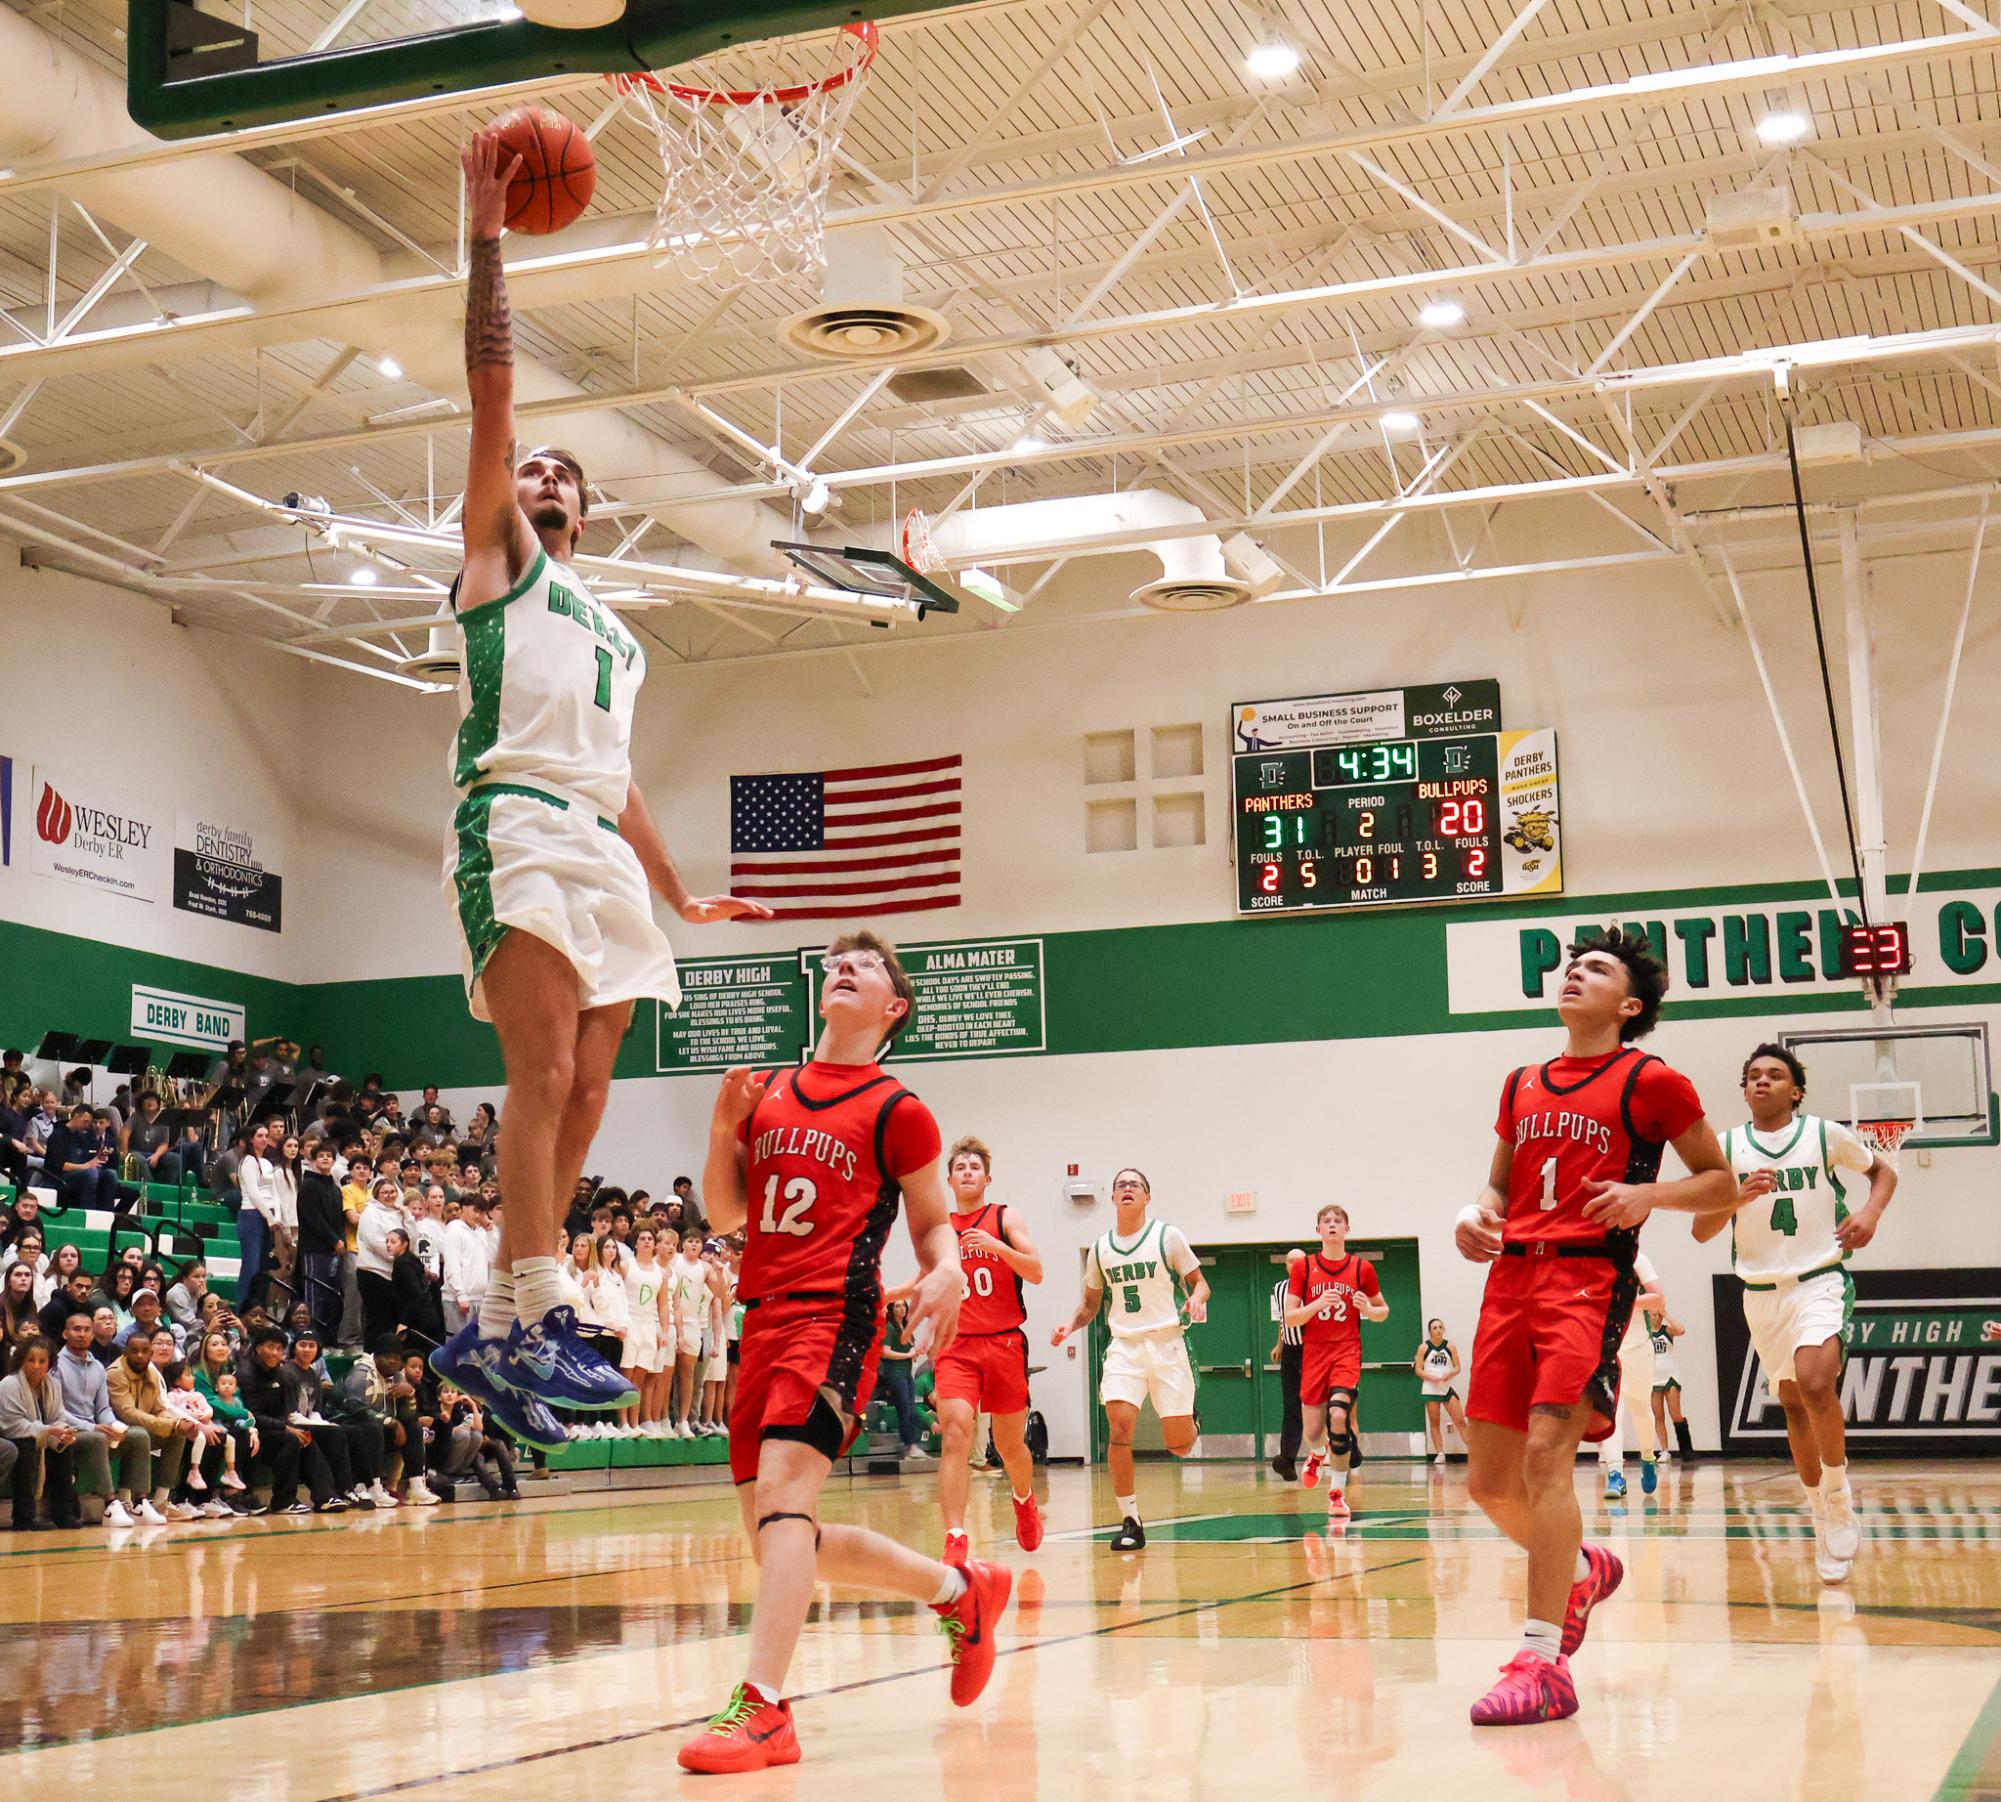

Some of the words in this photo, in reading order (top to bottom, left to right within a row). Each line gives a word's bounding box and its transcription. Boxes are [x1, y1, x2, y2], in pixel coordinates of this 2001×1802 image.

[548, 580, 637, 671] DERBY
[594, 645, 613, 712] 1
[1262, 713, 1295, 724] SMALL
[1298, 709, 1348, 720] BUSINESS
[1350, 703, 1399, 715] SUPPORT
[1288, 721, 1300, 730] On
[1301, 720, 1317, 729] and
[1319, 719, 1333, 728] Off
[1334, 718, 1348, 726] the
[1350, 716, 1374, 725] Court
[1413, 708, 1493, 726] BOXELDER
[1429, 723, 1477, 734] CONSULTING
[1338, 747, 1413, 780] 4:34
[1514, 751, 1544, 767] DERBY
[1505, 762, 1553, 781] PANTHERS
[1418, 778, 1488, 799] BULLPUPS
[1507, 788, 1553, 808] SHOCKERS
[1245, 793, 1313, 812] PANTHERS
[1348, 796, 1385, 809] PERIOD
[74, 804, 152, 849] WESLEY
[1359, 812, 1375, 837] 2
[1440, 800, 1483, 835] 20
[196, 820, 222, 839] derby
[223, 825, 253, 848] family
[1264, 815, 1304, 848] 31
[74, 833, 106, 858] Derby
[109, 841, 123, 860] ER
[196, 835, 252, 867] DENTISTRY
[1334, 845, 1374, 858] PLAYER
[1378, 843, 1405, 854] FOUL
[1416, 840, 1444, 852] T.O.L.
[1455, 836, 1489, 849] FOULS
[1250, 851, 1283, 864] FOULS
[1296, 849, 1325, 861] T.O.L.
[1468, 849, 1485, 876] 2
[195, 858, 202, 871] &
[203, 861, 263, 888] ORTHODONTICS
[1300, 862, 1317, 888] 5
[1423, 853, 1437, 879] 3
[1263, 864, 1279, 891] 2
[1456, 880, 1491, 893] SCORE
[1251, 895, 1284, 908] SCORE
[1351, 888, 1387, 900] MATCH
[926, 952, 966, 971] ALMA
[967, 949, 1015, 968] MATER
[685, 969, 734, 987] DERBY
[736, 966, 771, 983] HIGH
[916, 977, 941, 987] SCHOOL
[942, 976, 960, 985] DAYS
[974, 973, 1004, 983] SWIFTLY
[915, 994, 937, 1003] WHILE
[937, 993, 948, 1002] WE
[948, 992, 964, 1001] LIVE
[964, 991, 984, 1000] WE'LL
[984, 990, 1003, 999] EVER
[922, 986, 935, 995] ALL
[935, 985, 949, 994] TOO
[969, 981, 995, 991] THEY'LL
[691, 1009, 713, 1018] MAKES
[728, 1007, 746, 1016] LIVES
[721, 999, 748, 1008] PRAISES
[917, 1002, 952, 1012] MEMORIES
[962, 1000, 989, 1010] SCHOOL
[147, 1003, 187, 1030] DERBY
[196, 1011, 230, 1038] BAND
[725, 1016, 734, 1025] TO
[938, 1013, 963, 1023] DERBY
[963, 1012, 975, 1022] WE
[975, 1011, 994, 1021] LOVE
[974, 1020, 992, 1029] EACH
[992, 1018, 1016, 1029] HEART
[672, 1030, 687, 1039] MAY
[702, 1028, 720, 1037] LIVES
[904, 1034, 920, 1043] LIES
[921, 1033, 934, 1042] THE
[969, 1029, 988, 1039] TRUE
[679, 1047, 690, 1056] LET
[935, 1040, 958, 1050] NEVER
[959, 1039, 969, 1048] TO
[753, 1127, 858, 1182] BULLPUPS
[1540, 1156, 1558, 1211] 1
[759, 1174, 818, 1237] 12
[1770, 1198, 1798, 1237] 4
[1105, 1260, 1158, 1284] DERBY
[1122, 1284, 1142, 1313] 5
[1891, 1320, 1964, 1343] HIGH
